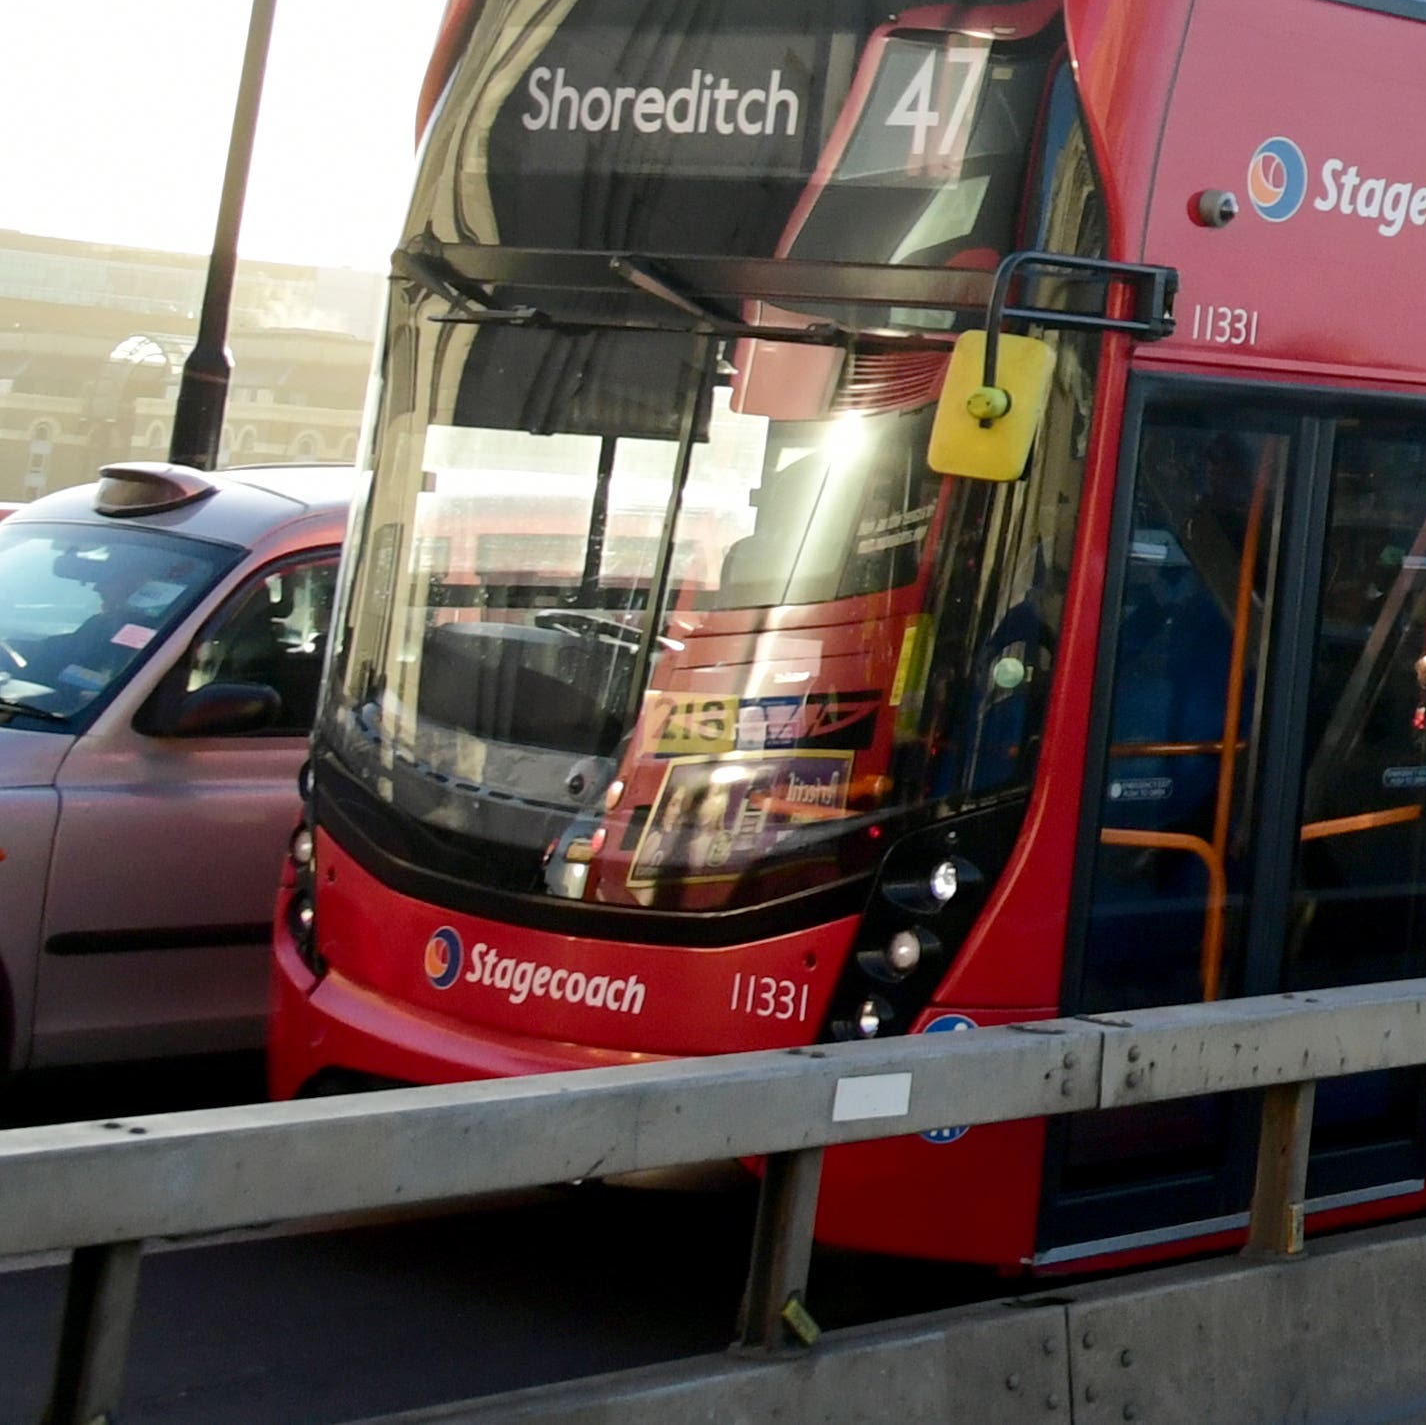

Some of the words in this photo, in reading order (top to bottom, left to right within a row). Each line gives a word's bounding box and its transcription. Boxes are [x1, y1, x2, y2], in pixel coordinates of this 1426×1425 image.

[521, 65, 799, 136] Shoreditch
[884, 48, 984, 156] 47
[1192, 304, 1259, 346] 11331
[465, 941, 646, 1015] Stagecoach
[729, 971, 809, 1022] 11331
